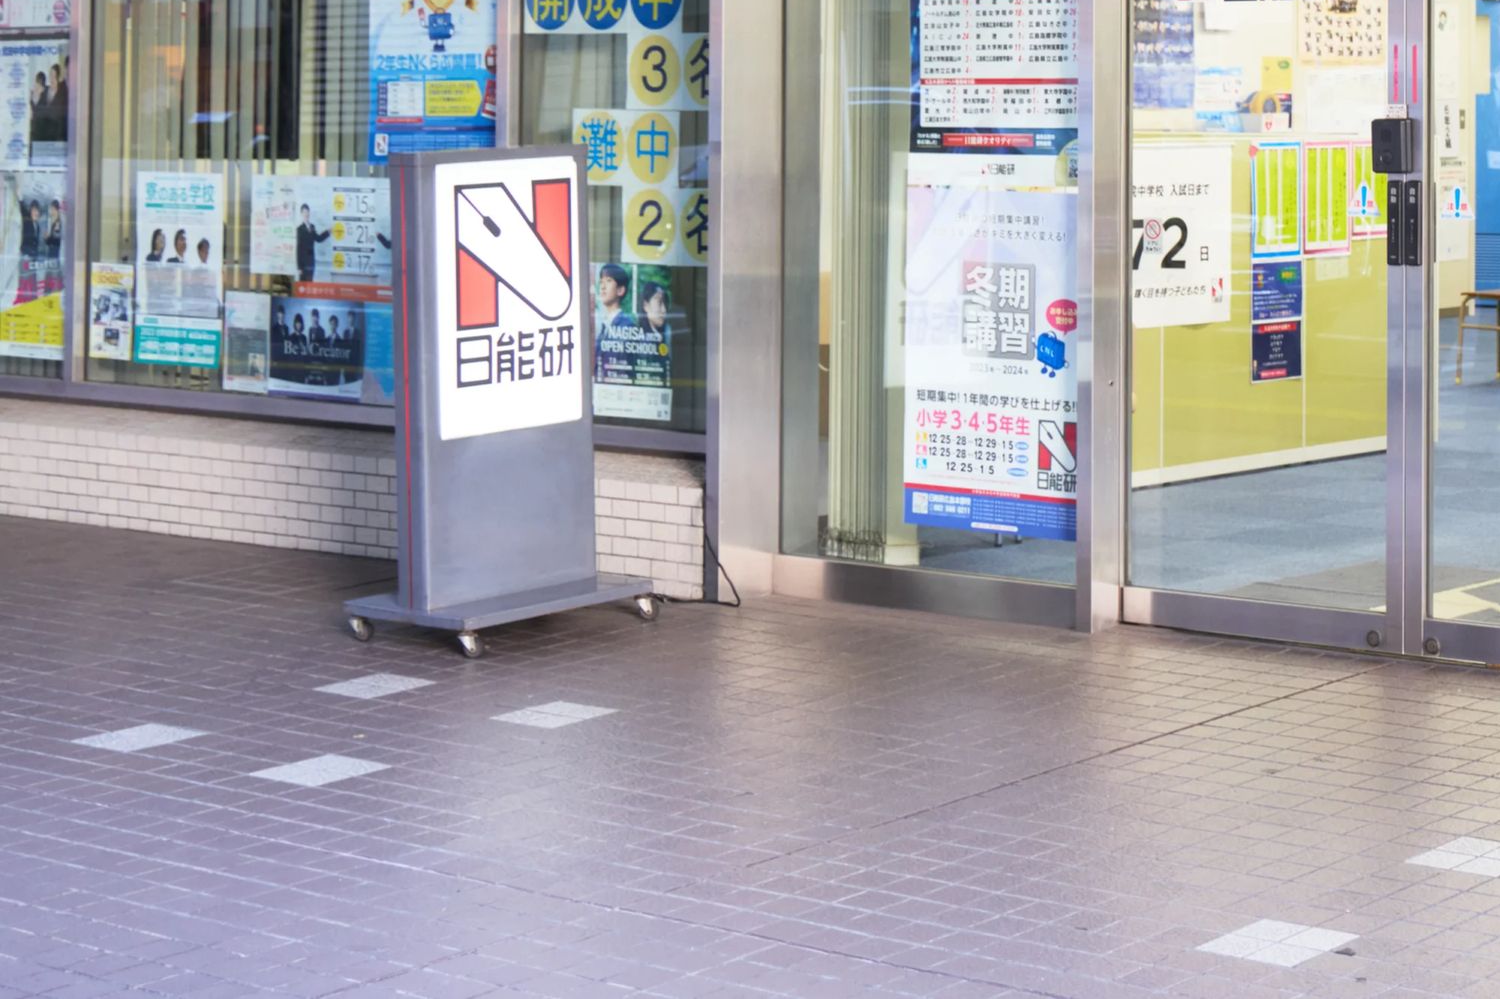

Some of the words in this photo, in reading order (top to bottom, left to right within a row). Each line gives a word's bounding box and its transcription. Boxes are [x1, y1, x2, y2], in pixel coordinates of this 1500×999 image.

[1170, 184, 1210, 196] 入試日まで
[965, 265, 1031, 310] 冬期
[608, 325, 645, 341] NAGISA
[964, 309, 1031, 355] 講習
[284, 340, 298, 355] Be
[309, 341, 350, 359] Creator
[456, 325, 574, 389] 日能研
[600, 340, 624, 353] OPEN
[626, 342, 659, 356] SCHOOL
[1037, 471, 1077, 493] 日能研
